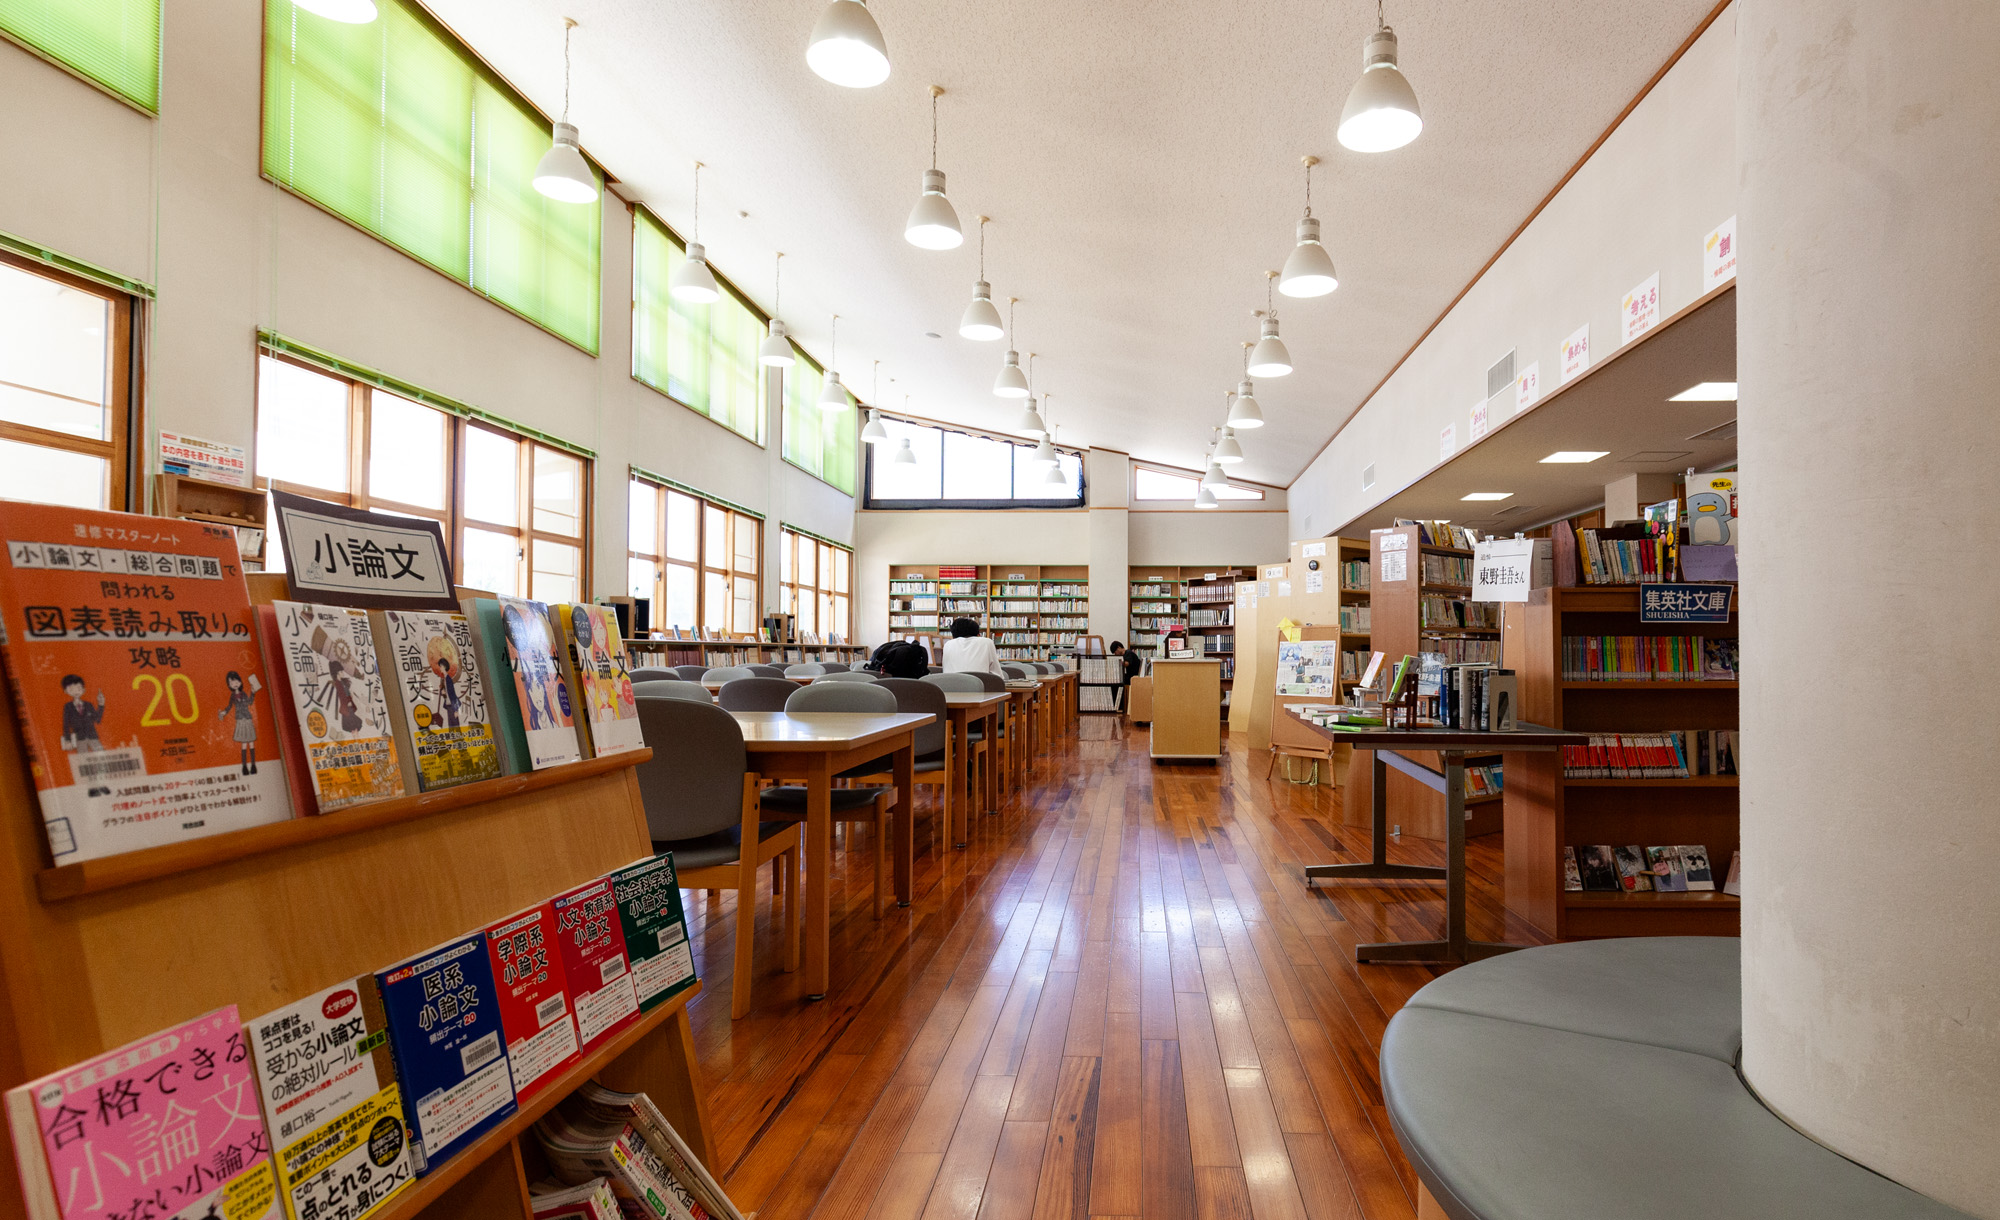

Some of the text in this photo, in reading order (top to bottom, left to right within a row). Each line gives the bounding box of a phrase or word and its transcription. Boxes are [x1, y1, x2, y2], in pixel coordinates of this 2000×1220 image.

[1631, 287, 1656, 316] 考える
[1568, 336, 1587, 362] 集める
[16, 546, 237, 577] 小論文・総合問題で
[314, 532, 426, 582] 小論文
[101, 581, 176, 600] 問われる
[1480, 566, 1525, 586] 東野圭吾さん
[1646, 590, 1727, 612] 集英社文庫
[24, 605, 248, 638] 図表読み取りの
[130, 646, 181, 669] 攻略
[285, 608, 324, 708] 小論文
[395, 616, 430, 702] 小論文
[453, 622, 485, 722] 読むだけ
[580, 650, 630, 681] 小論文
[350, 618, 387, 735] 読むだけ
[131, 673, 200, 727] 20
[615, 867, 673, 904] 社会科学系
[558, 892, 615, 933] 人文・教育系
[630, 889, 668, 918] 小論文
[498, 924, 544, 962] 学際系
[574, 916, 610, 947] 小論文
[414, 944, 472, 974] 書き方のコツがよくわかる
[504, 948, 548, 986] 小論文
[422, 962, 464, 1001] 医系
[326, 994, 354, 1014] 大学受験
[419, 985, 479, 1031] 小論文
[260, 1014, 301, 1042] 採点者は
[264, 1020, 316, 1054] ココを見る!
[358, 1030, 386, 1053] 最新版
[429, 1012, 476, 1045] 頻出テーマ20
[266, 1016, 365, 1081] 受かる小論文
[272, 1046, 357, 1101] の絶対ルール
[45, 1033, 248, 1150] 合格できる
[280, 1106, 327, 1139] 樋口裕一
[64, 1074, 261, 1213] 小論文
[296, 1169, 336, 1200] この一冊で
[302, 1162, 372, 1220] 点のとれる
